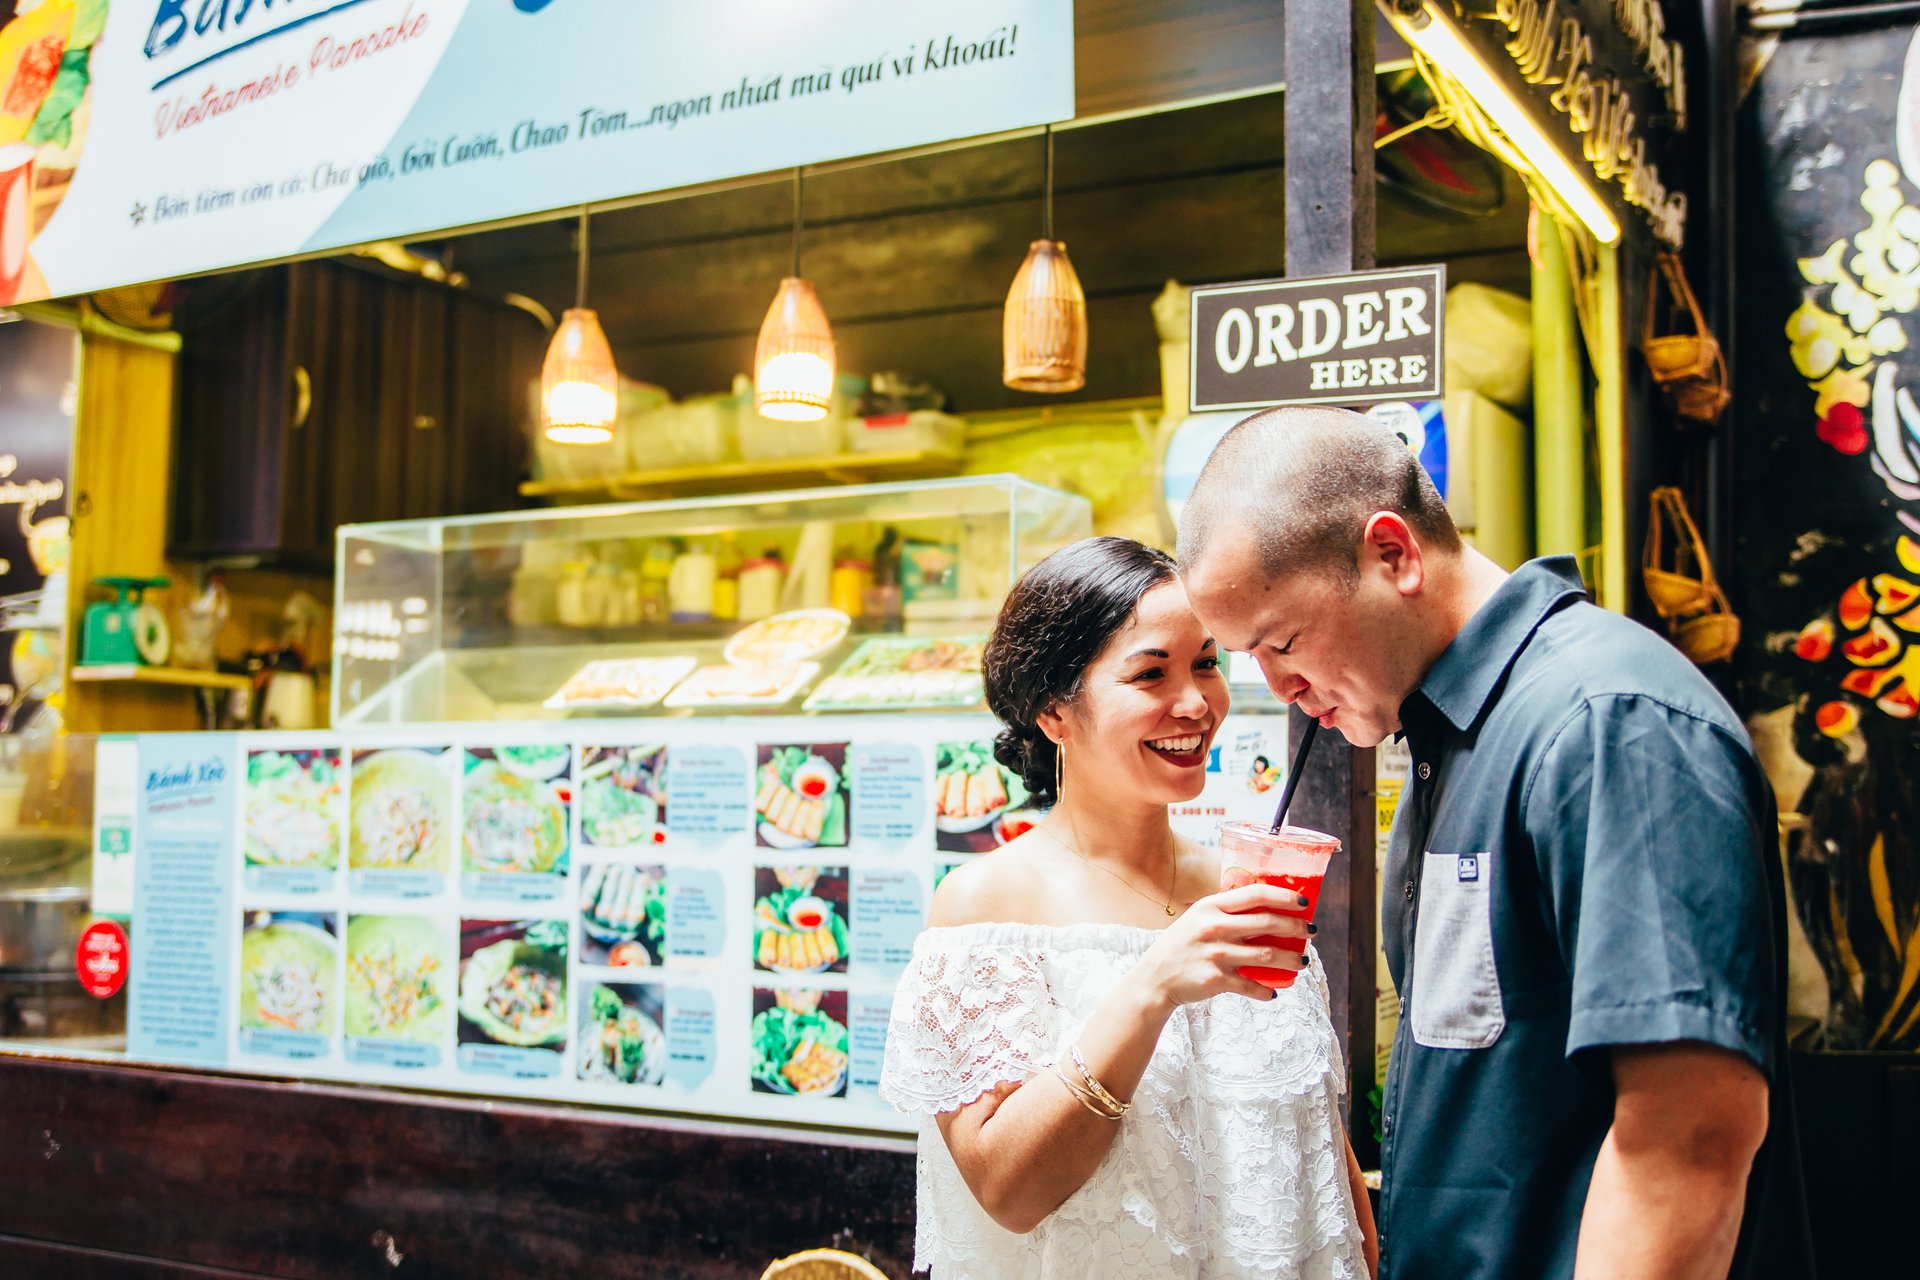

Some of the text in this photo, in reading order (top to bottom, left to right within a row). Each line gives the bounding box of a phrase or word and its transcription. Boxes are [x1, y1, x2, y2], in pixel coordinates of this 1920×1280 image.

[156, 1, 429, 139] Vietnamese Pancake
[923, 24, 1018, 72] khoái!
[1214, 286, 1431, 375] ORDER
[1309, 354, 1428, 390] HERE
